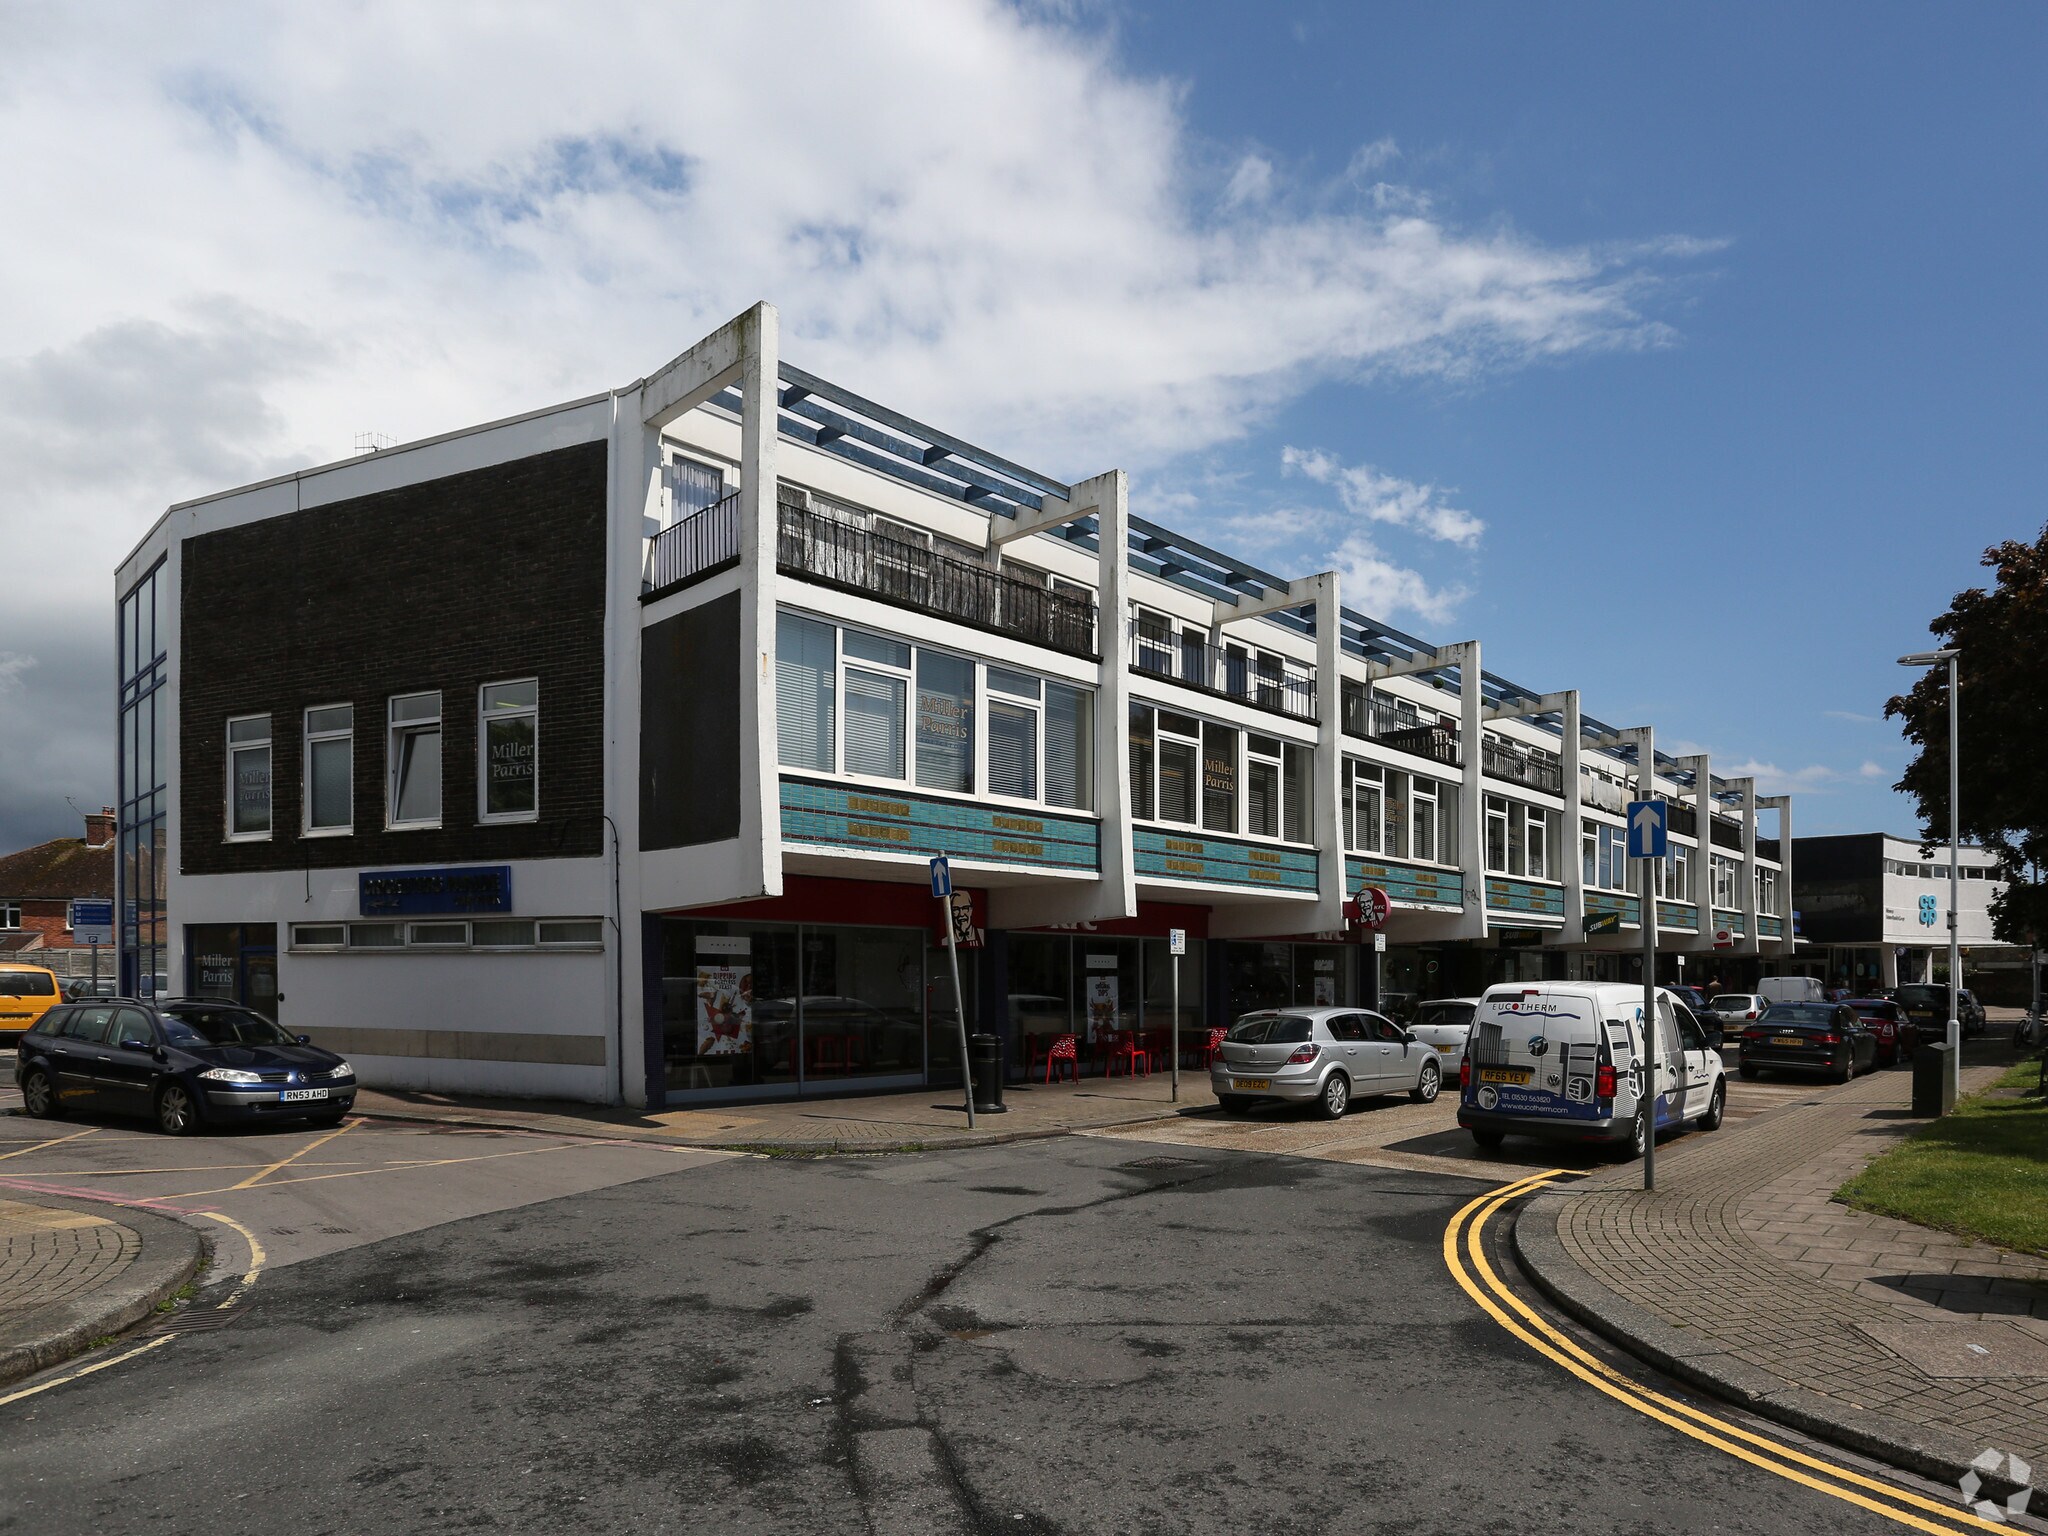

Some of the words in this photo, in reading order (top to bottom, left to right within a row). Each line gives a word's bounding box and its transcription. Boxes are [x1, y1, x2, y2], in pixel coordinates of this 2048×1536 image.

[921, 695, 968, 719] Miller
[922, 715, 968, 738] Parris
[492, 741, 534, 760] Miller
[493, 762, 534, 778] Parris
[1205, 760, 1234, 775] Miller
[1206, 774, 1234, 790] Parris
[1588, 915, 1617, 932] SUBWAY
[1503, 931, 1538, 939] SUBWAY
[202, 953, 233, 967] Miller
[203, 969, 233, 982] Parris
[1492, 1003, 1557, 1012] EUCOTHERM
[1484, 1070, 1507, 1081] RF66
[1509, 1072, 1527, 1083] YEV
[1235, 1080, 1252, 1088] DE09
[286, 1091, 310, 1100] RN53
[311, 1089, 327, 1098] AHD
[1501, 1092, 1511, 1100] TEL
[1501, 1103, 1569, 1113] www.eucotherm.com
